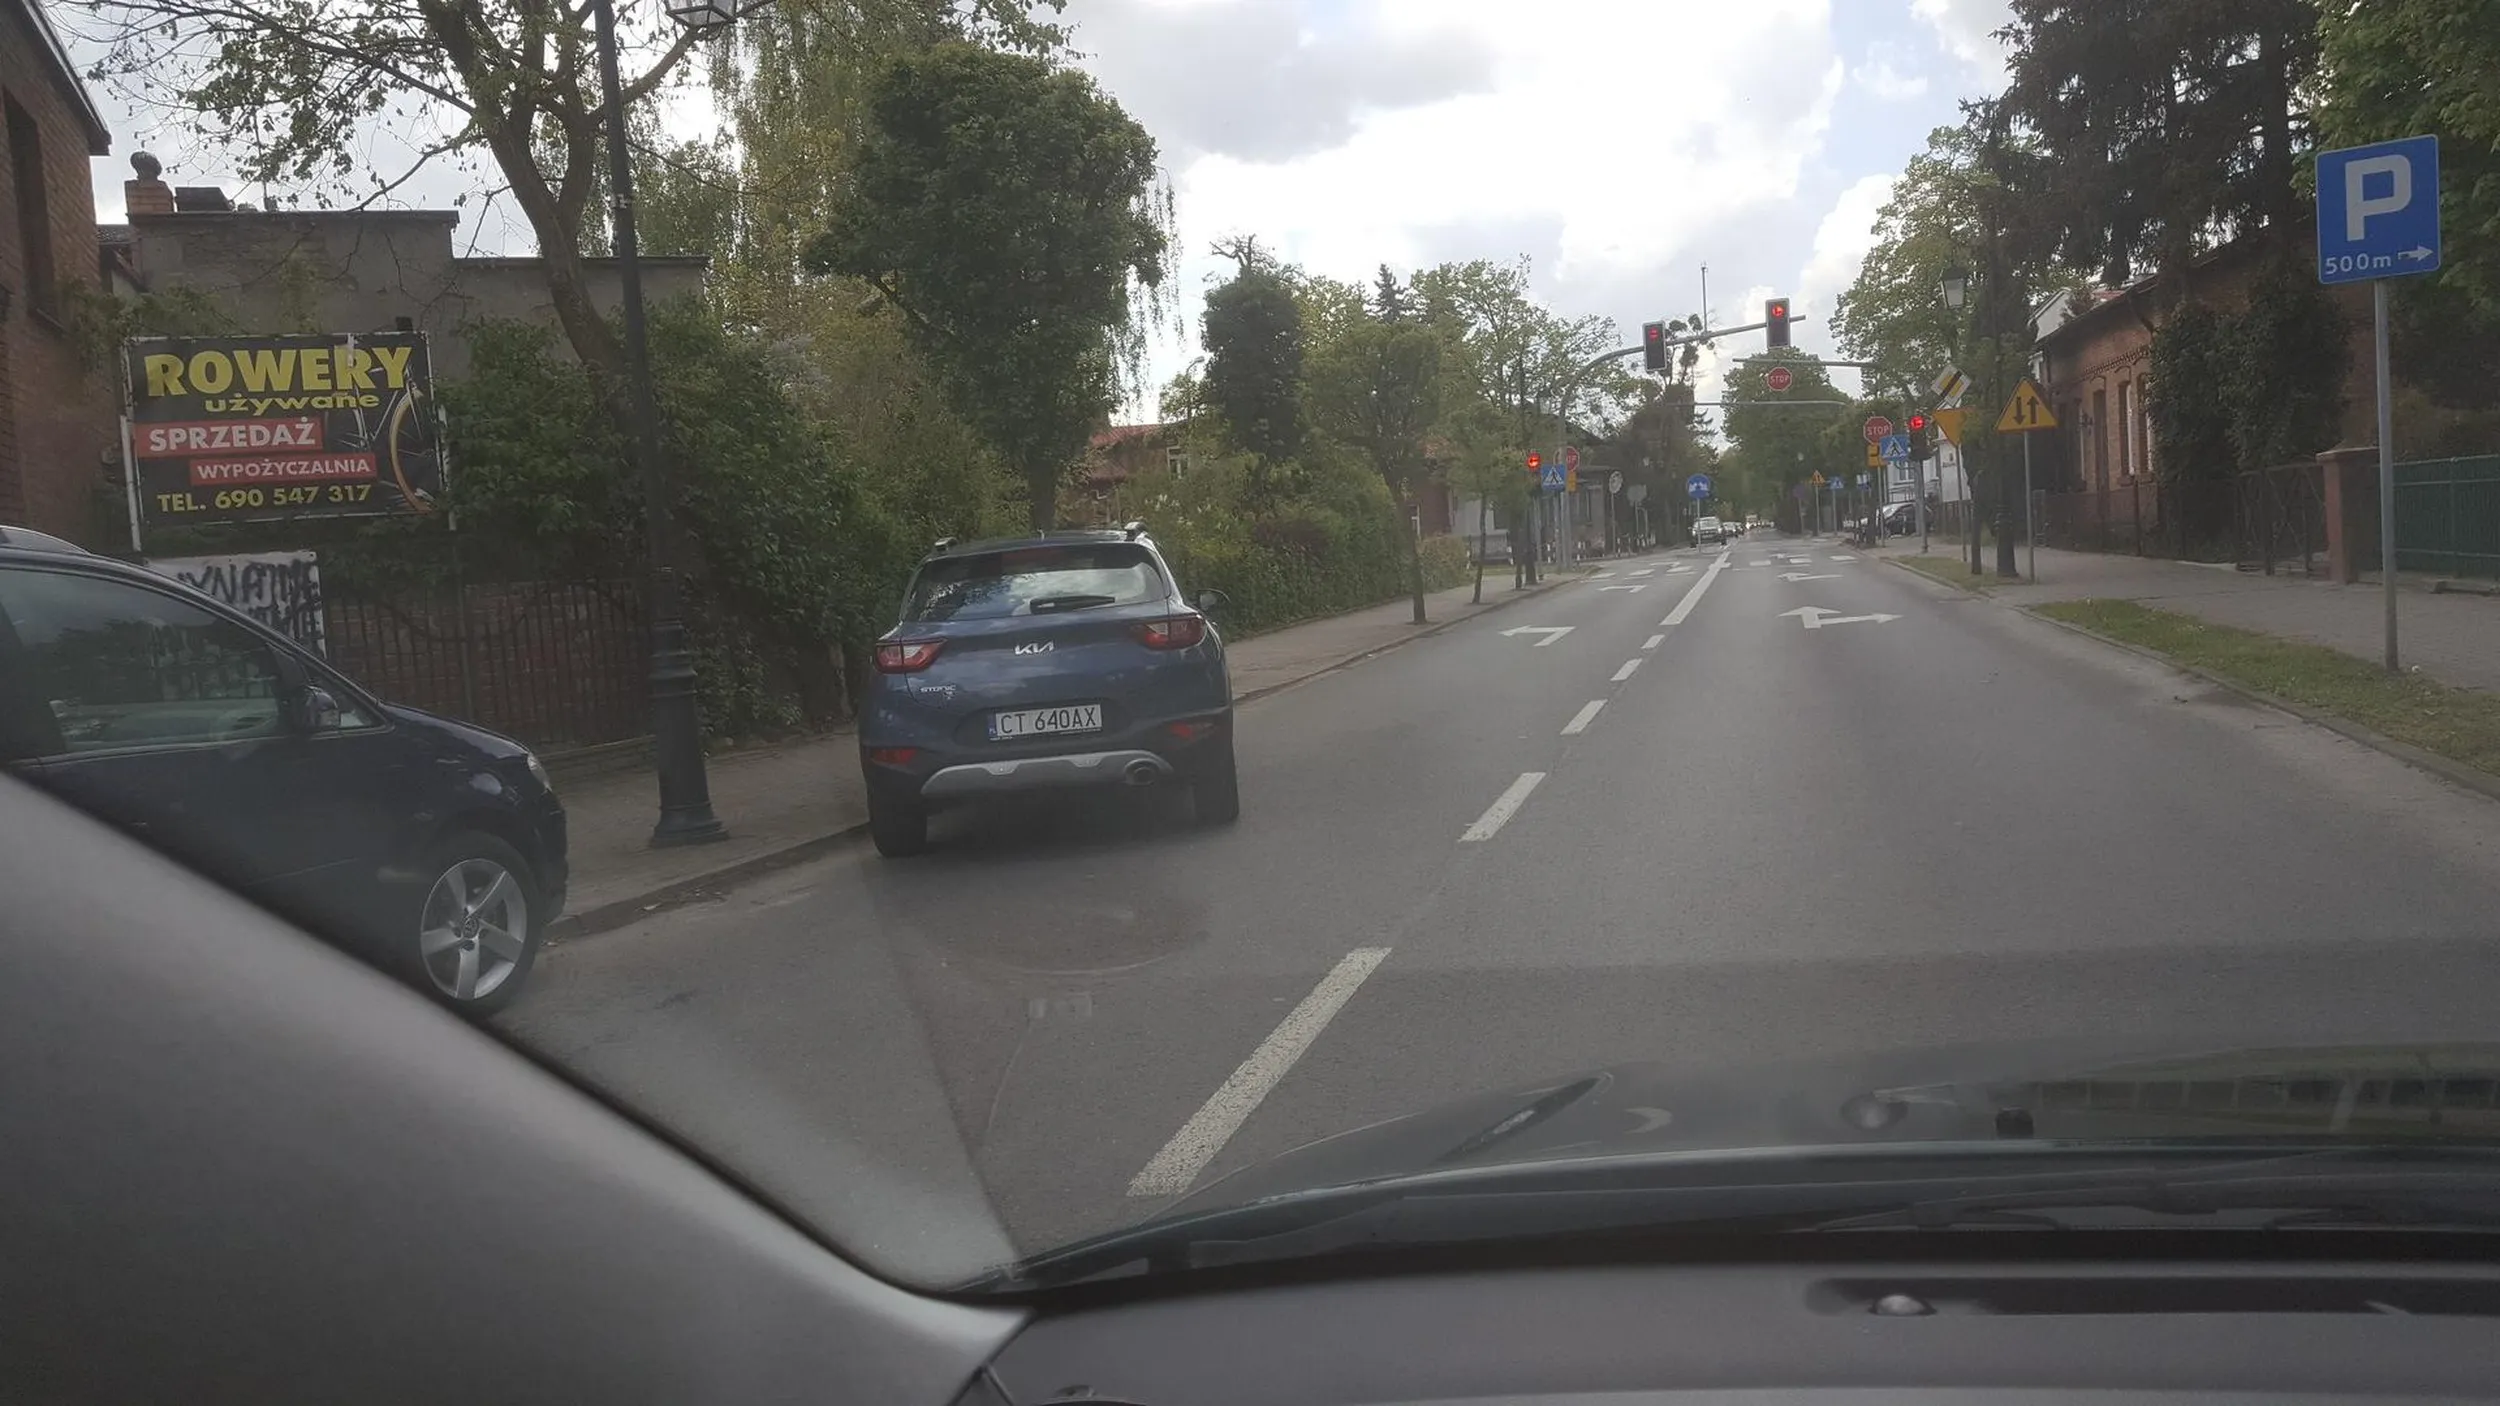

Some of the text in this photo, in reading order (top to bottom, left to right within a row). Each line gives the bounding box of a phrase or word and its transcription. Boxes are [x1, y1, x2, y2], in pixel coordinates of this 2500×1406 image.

[2345, 154, 2411, 241] P
[2325, 253, 2392, 275] 500m
[144, 346, 412, 396] ROWERY
[1770, 374, 1790, 384] STOP
[205, 393, 381, 416] używane
[149, 416, 316, 452] SPRZEDAŻ
[1867, 425, 1889, 436] STOP
[197, 458, 371, 480] WYPOŻYCZALNIA
[158, 484, 372, 512] TEL. 690 547 317
[1015, 640, 1054, 655] KIA
[1001, 707, 1096, 734] CT 640AX
